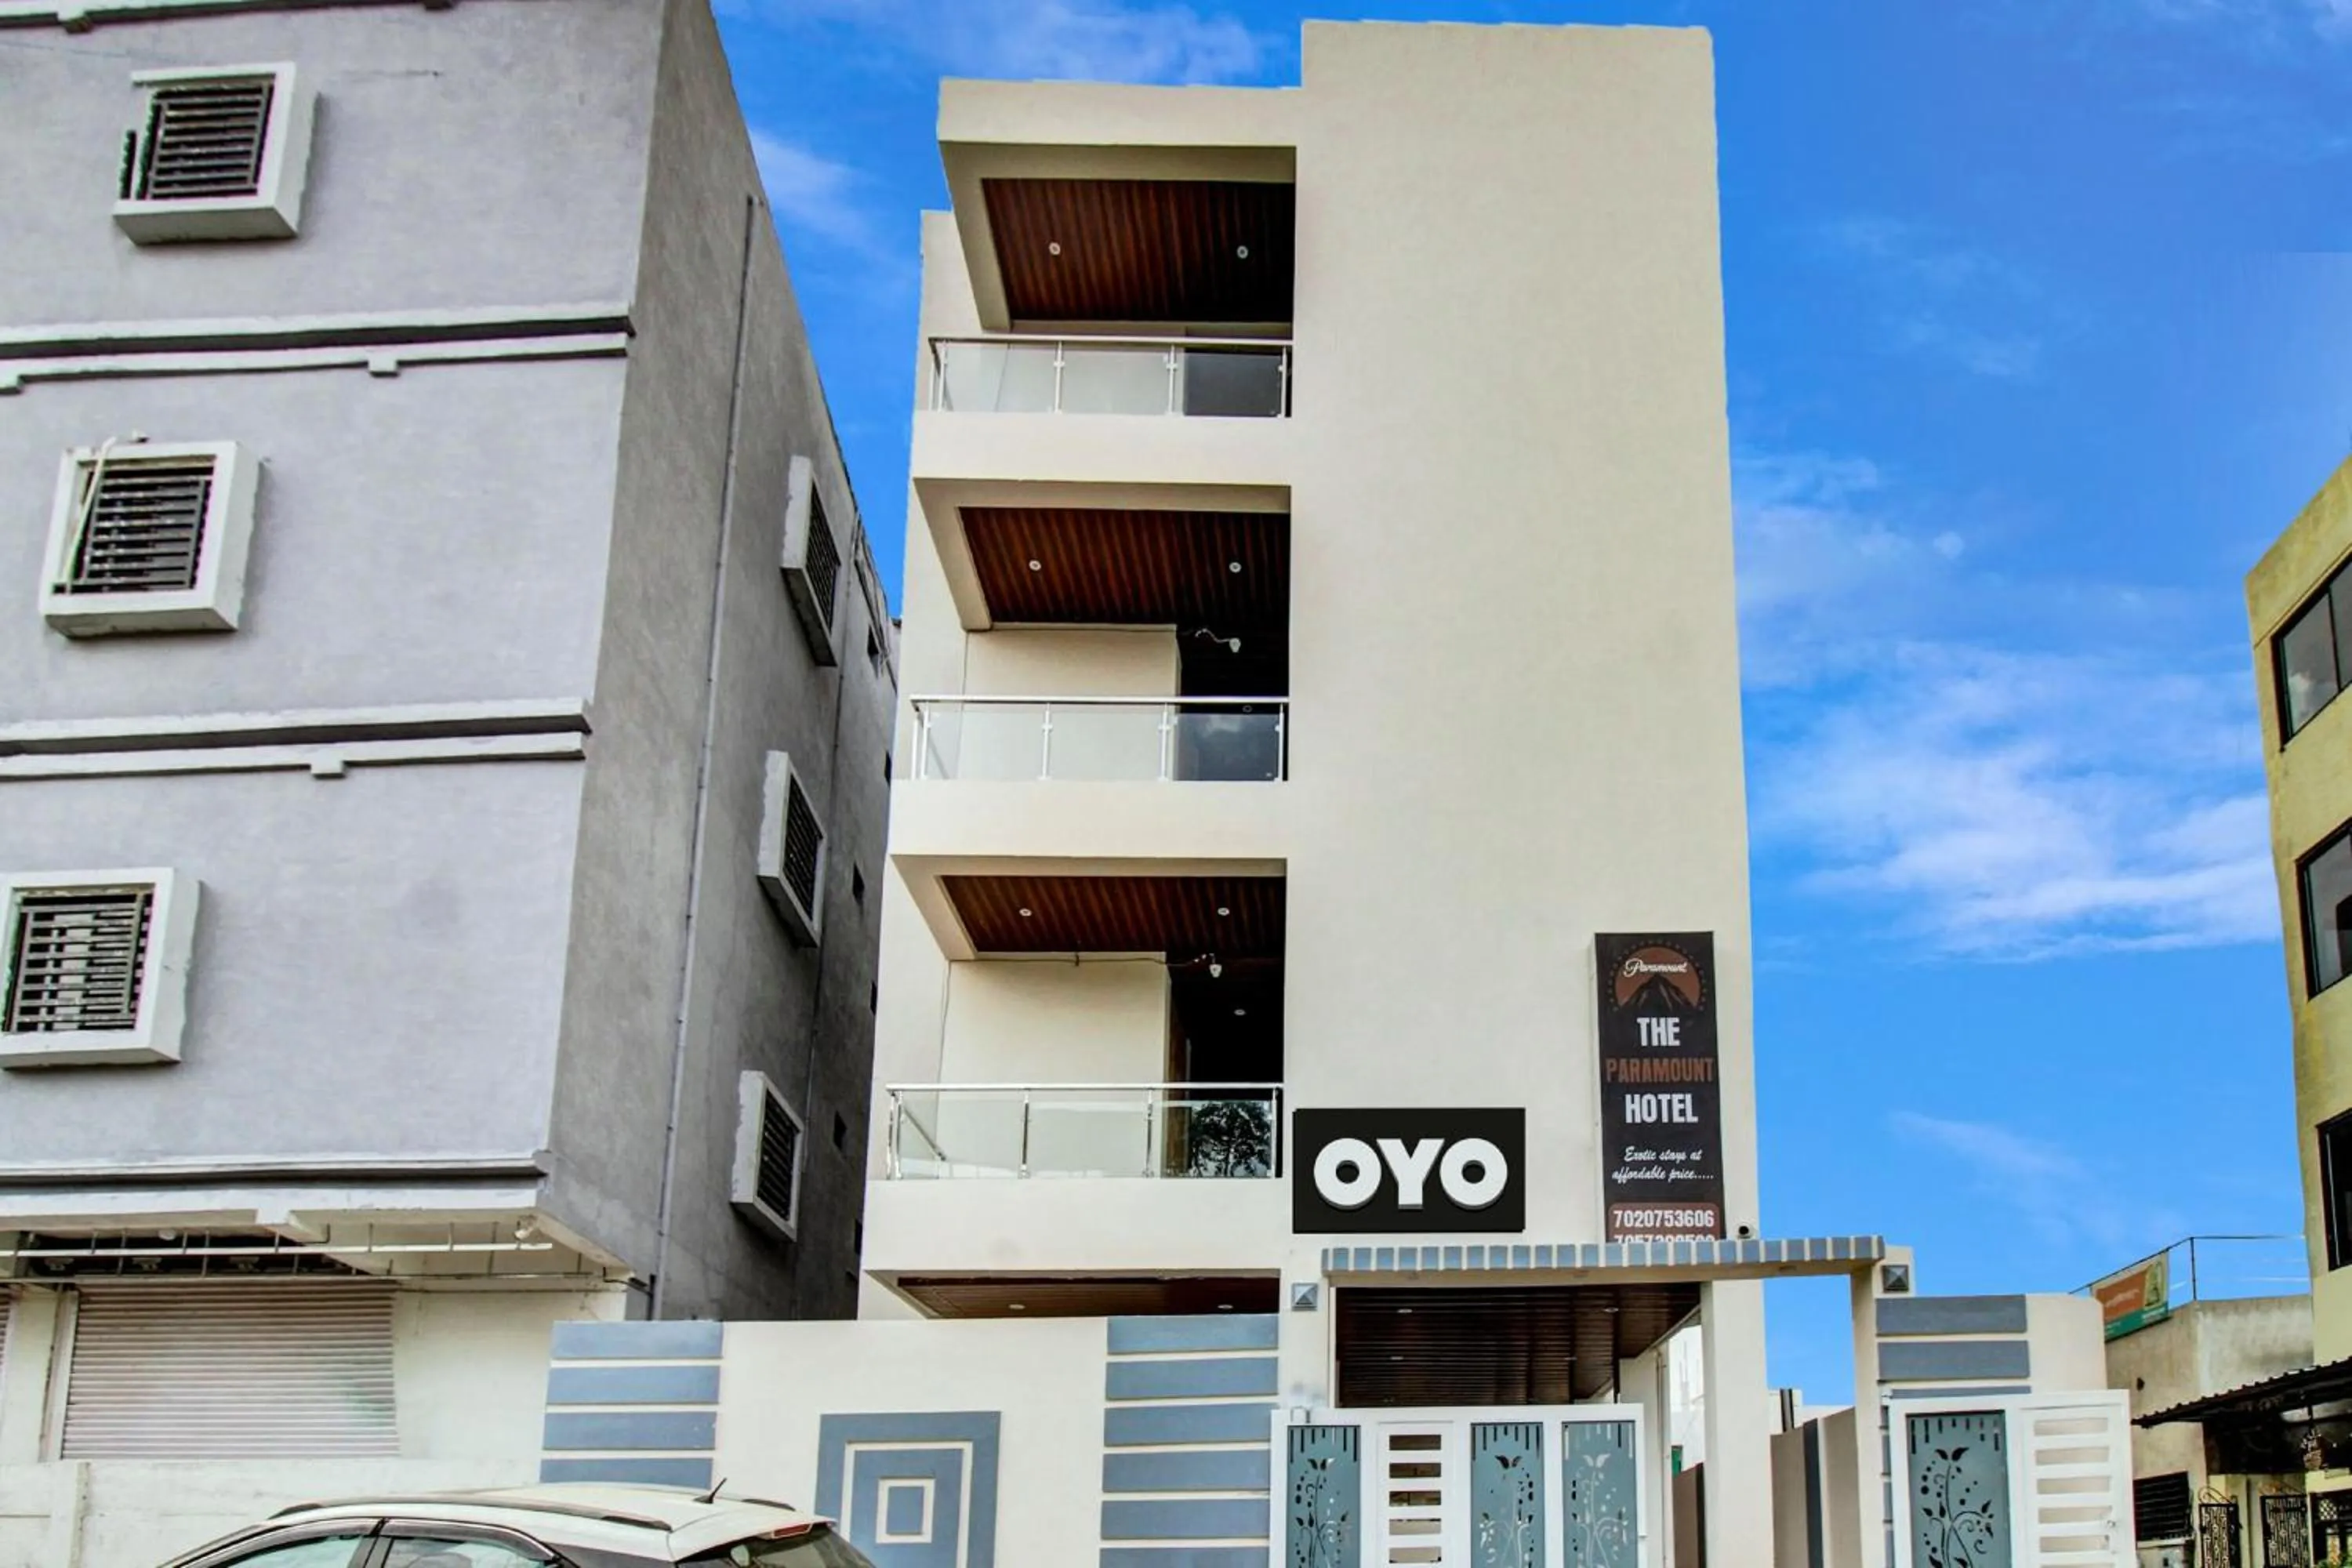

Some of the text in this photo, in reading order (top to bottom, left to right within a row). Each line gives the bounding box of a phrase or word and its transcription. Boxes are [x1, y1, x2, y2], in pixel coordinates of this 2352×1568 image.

[1623, 957, 1687, 978] Paramount
[1636, 1017, 1681, 1047] THE
[1606, 1058, 1714, 1082] PARAMOUNT
[1624, 1093, 1699, 1123] HOTEL
[1624, 1145, 1702, 1163] Exotic stays at
[1313, 1138, 1508, 1210] OYO
[1612, 1164, 1666, 1184] affordable
[1613, 1210, 1715, 1228] 7020753606
